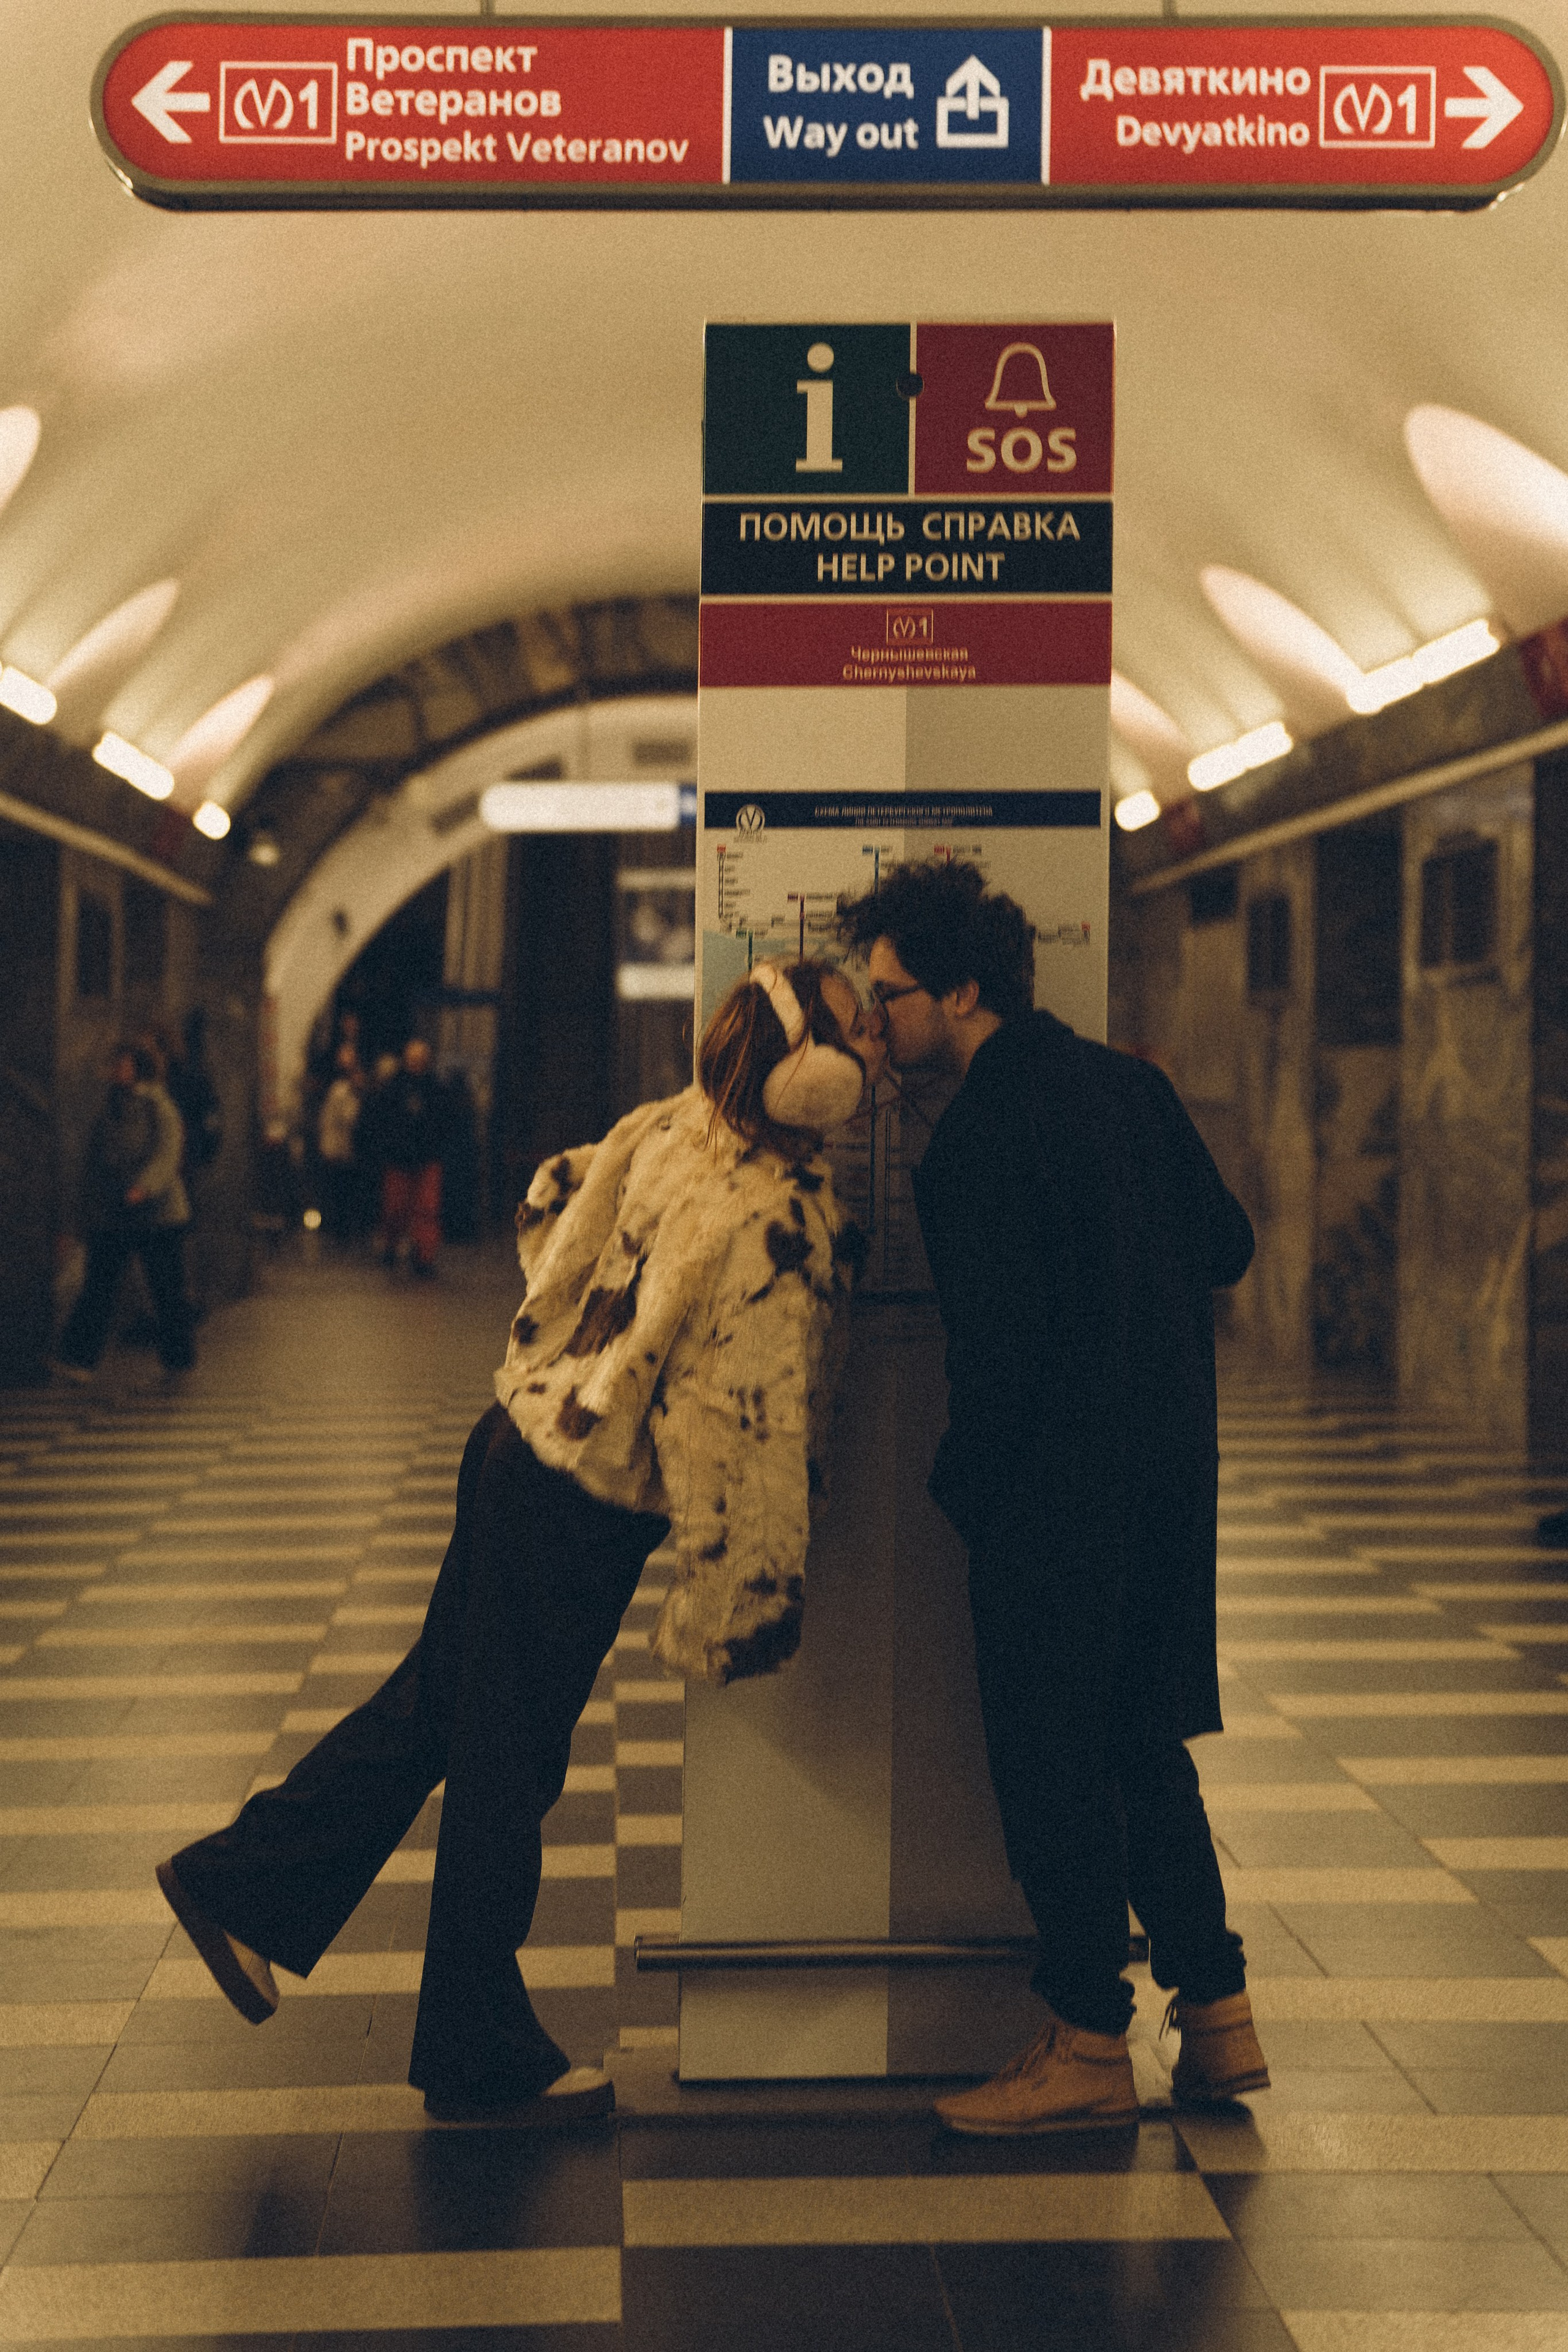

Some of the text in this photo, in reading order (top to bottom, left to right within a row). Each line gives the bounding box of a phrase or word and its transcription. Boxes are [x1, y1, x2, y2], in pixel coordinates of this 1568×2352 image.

[346, 37, 538, 80] Проспект
[767, 55, 914, 99] Выход
[1079, 58, 1311, 102] Девяткино
[345, 81, 562, 124] Ветеранов
[345, 130, 689, 168] Prospekt Veteranov
[763, 116, 919, 157] Way out
[1116, 113, 1311, 154] Devyatkino
[966, 427, 1078, 473] SOS
[739, 512, 1080, 546] ПОМОЩЬ СПРАВКА
[816, 552, 1005, 582] HELP POINT
